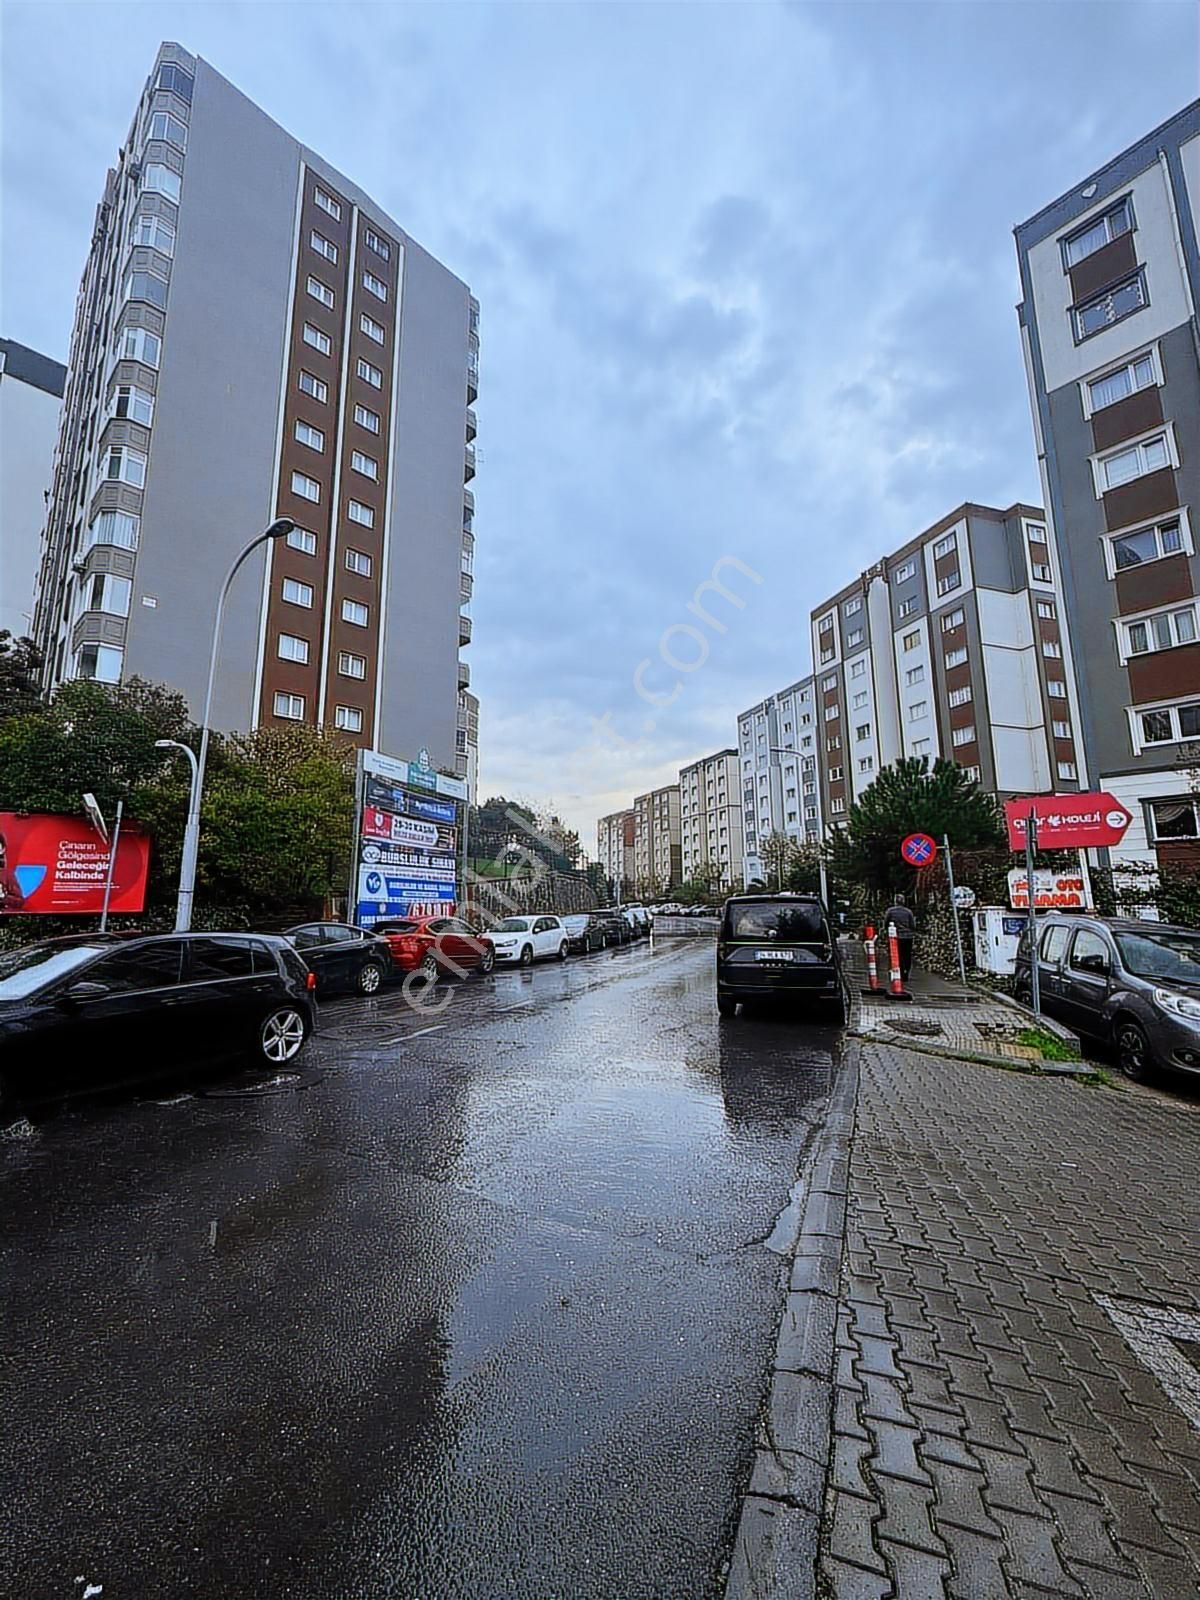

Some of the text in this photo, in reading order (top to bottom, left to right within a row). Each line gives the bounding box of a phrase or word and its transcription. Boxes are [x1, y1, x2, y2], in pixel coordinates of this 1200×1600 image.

[58, 850, 111, 861] Gölgesind
[55, 870, 105, 880] Kalbinde
[1056, 878, 1084, 892] OTO
